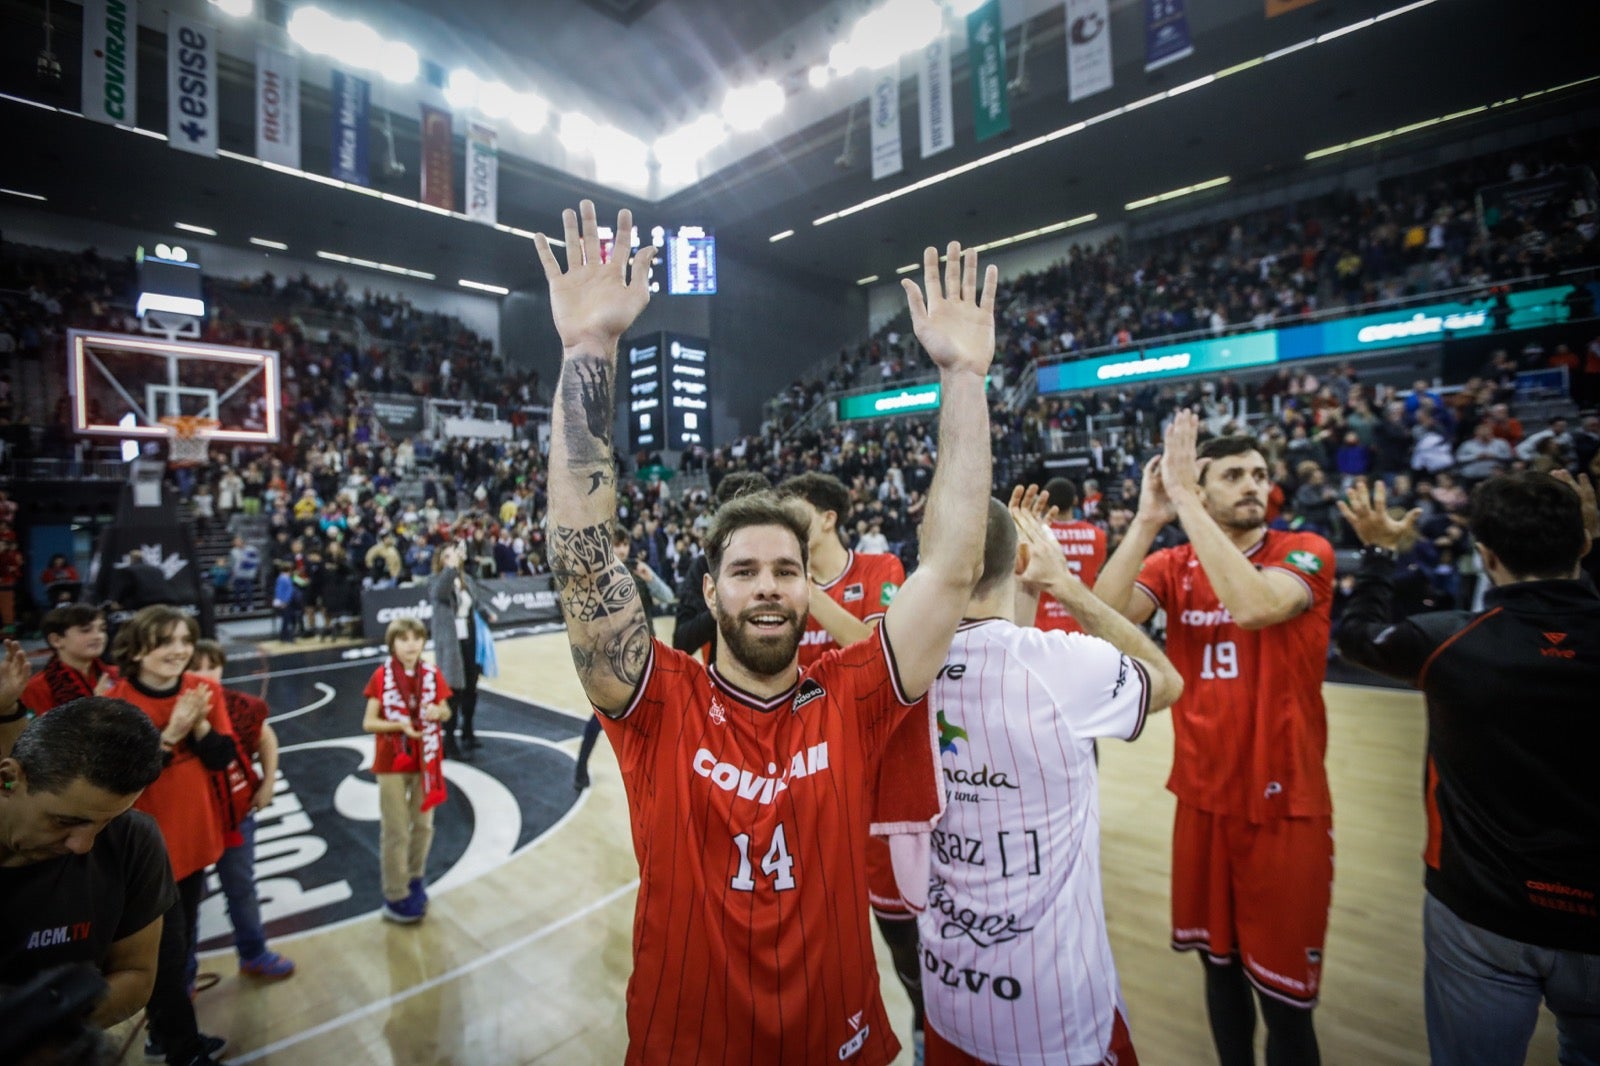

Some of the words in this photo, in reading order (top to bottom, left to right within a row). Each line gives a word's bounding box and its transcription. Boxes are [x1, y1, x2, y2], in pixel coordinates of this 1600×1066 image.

[1201, 640, 1239, 679] 19
[730, 821, 796, 893] 14
[930, 829, 985, 866] gaz
[27, 921, 92, 949] ACM.TV
[917, 944, 1022, 1002] OLVO
